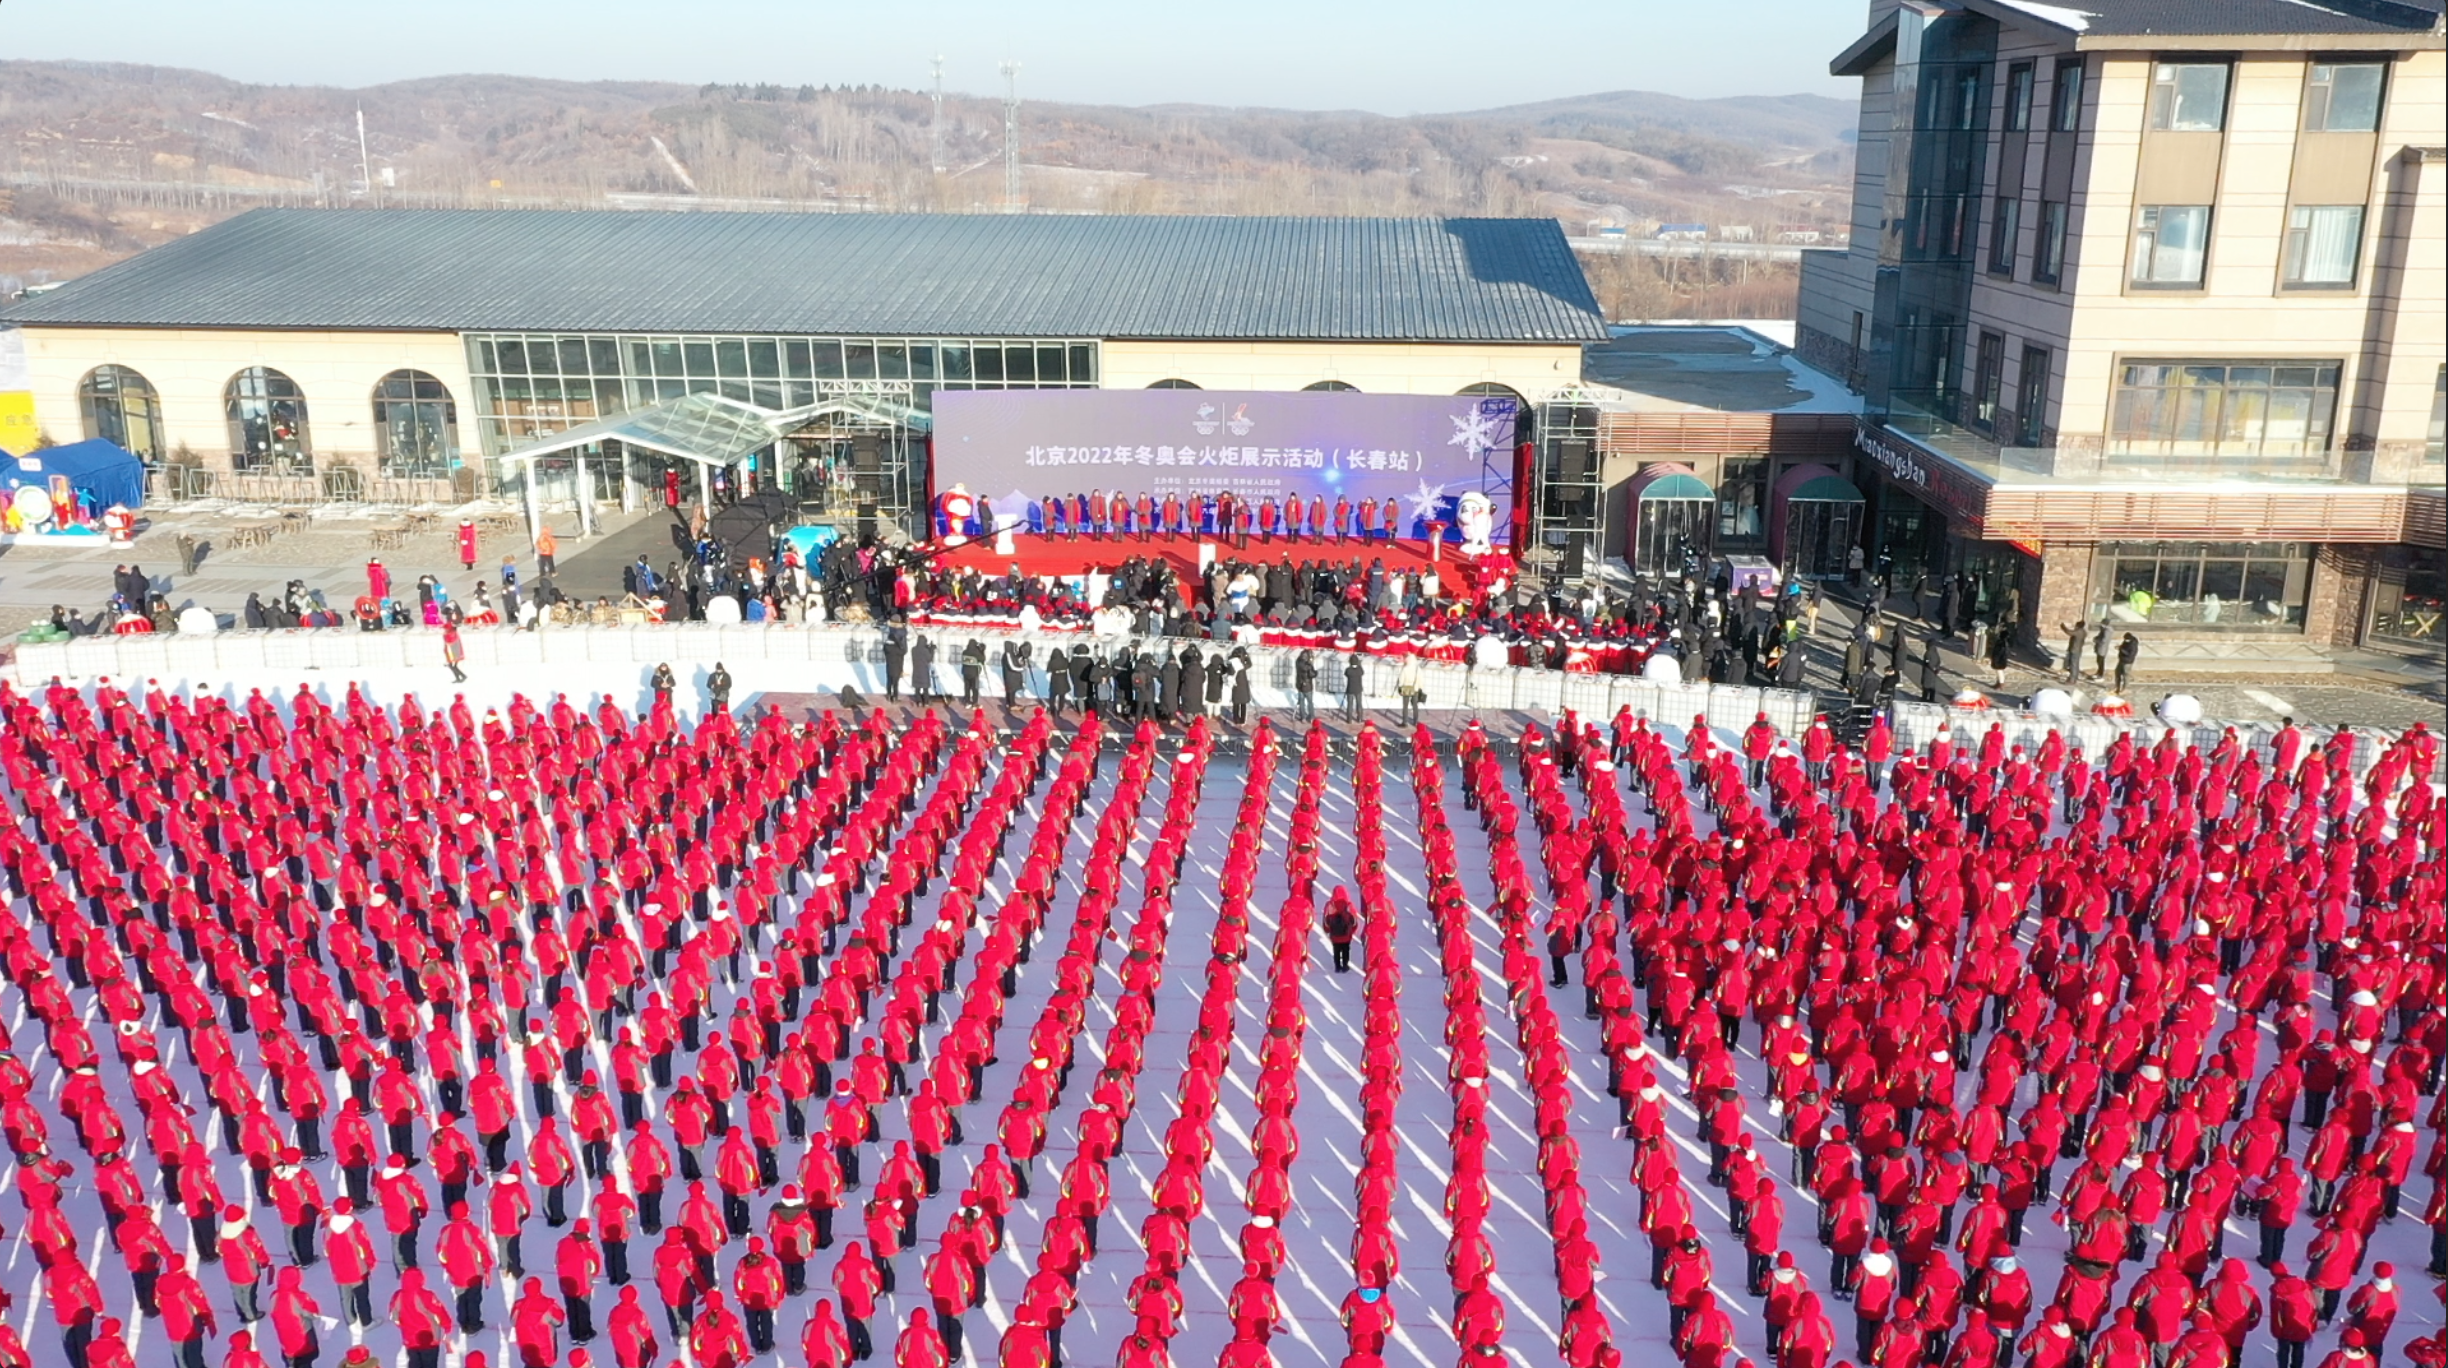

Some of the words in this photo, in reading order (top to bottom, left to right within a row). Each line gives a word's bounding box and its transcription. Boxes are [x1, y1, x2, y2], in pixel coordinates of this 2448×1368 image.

[1025, 445, 1424, 472] 北京2022年冬奥会火炬展示活动（长春站）
